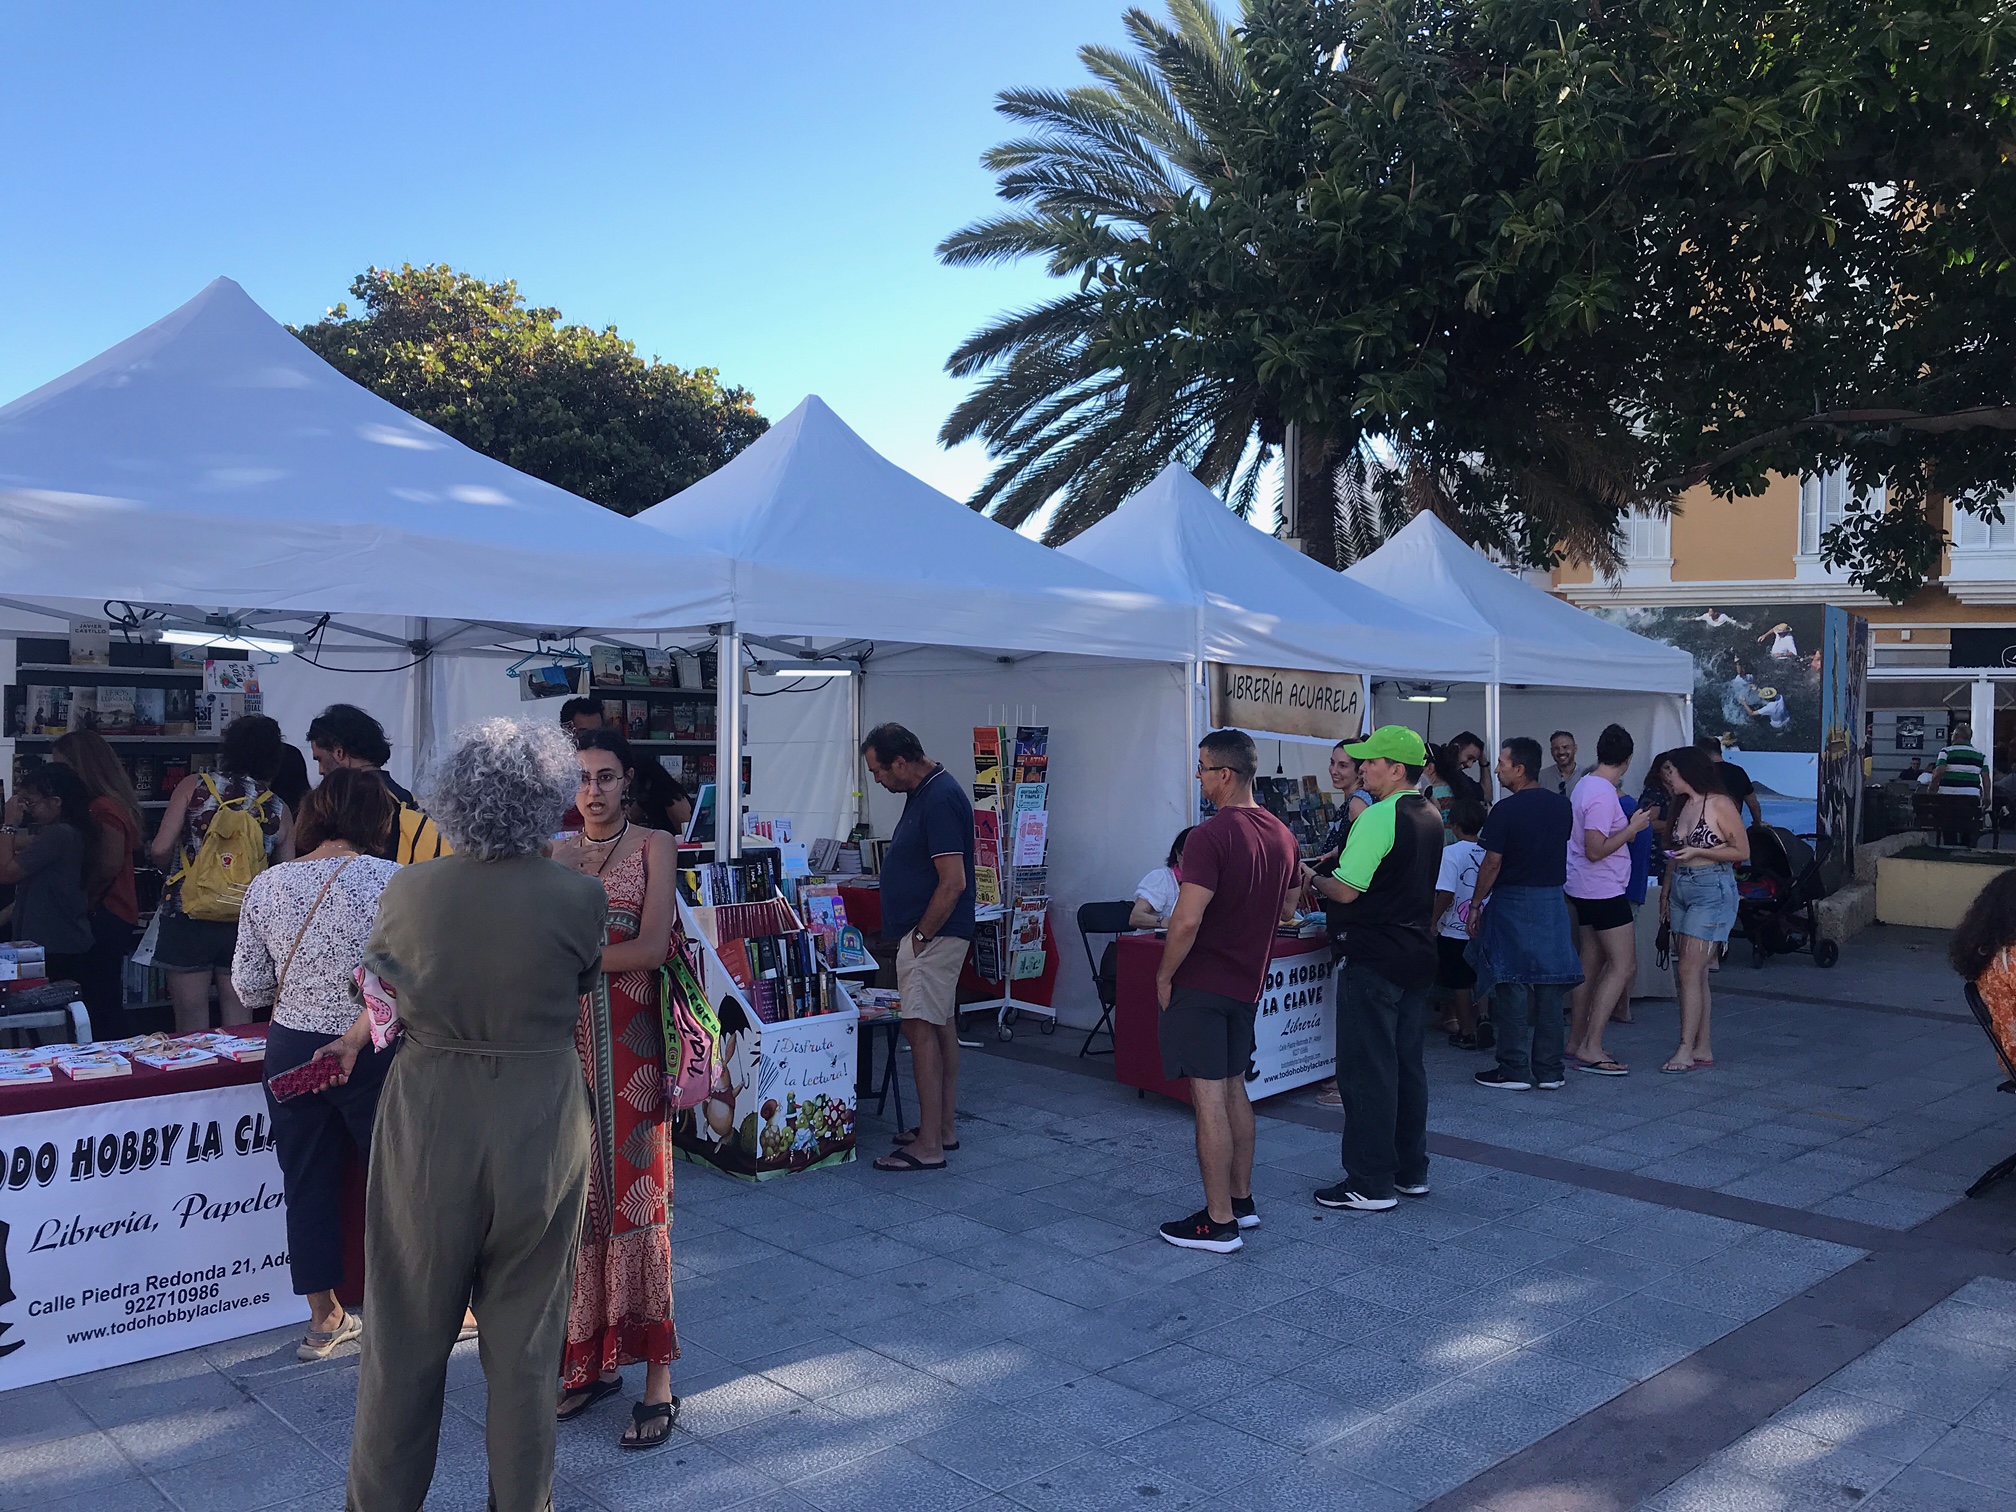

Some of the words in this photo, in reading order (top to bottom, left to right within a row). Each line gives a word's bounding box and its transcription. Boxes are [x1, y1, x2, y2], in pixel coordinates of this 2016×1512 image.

[1225, 672, 1283, 705] LIBRERÍA
[1289, 683, 1358, 715] ACUARELA
[1288, 961, 1333, 987] HOBBY
[1262, 996, 1279, 1017] LA
[1284, 986, 1323, 1012] CLAVE
[1280, 1013, 1322, 1037] Librería
[772, 1036, 835, 1054] ¡Disfruta
[784, 1068, 797, 1087] la
[802, 1062, 848, 1087] lectura!
[0, 1141, 58, 1191] DO
[70, 1123, 183, 1182] HOBBY
[186, 1120, 223, 1162] LA
[27, 1209, 160, 1254] Librería,
[27, 1294, 75, 1318] Calle
[81, 1281, 140, 1307] Piedra
[145, 1264, 226, 1292] Redonda
[231, 1258, 256, 1277] 21,
[124, 1282, 220, 1316] 922710986
[66, 1291, 271, 1345] www.todohobbylaclave.es
